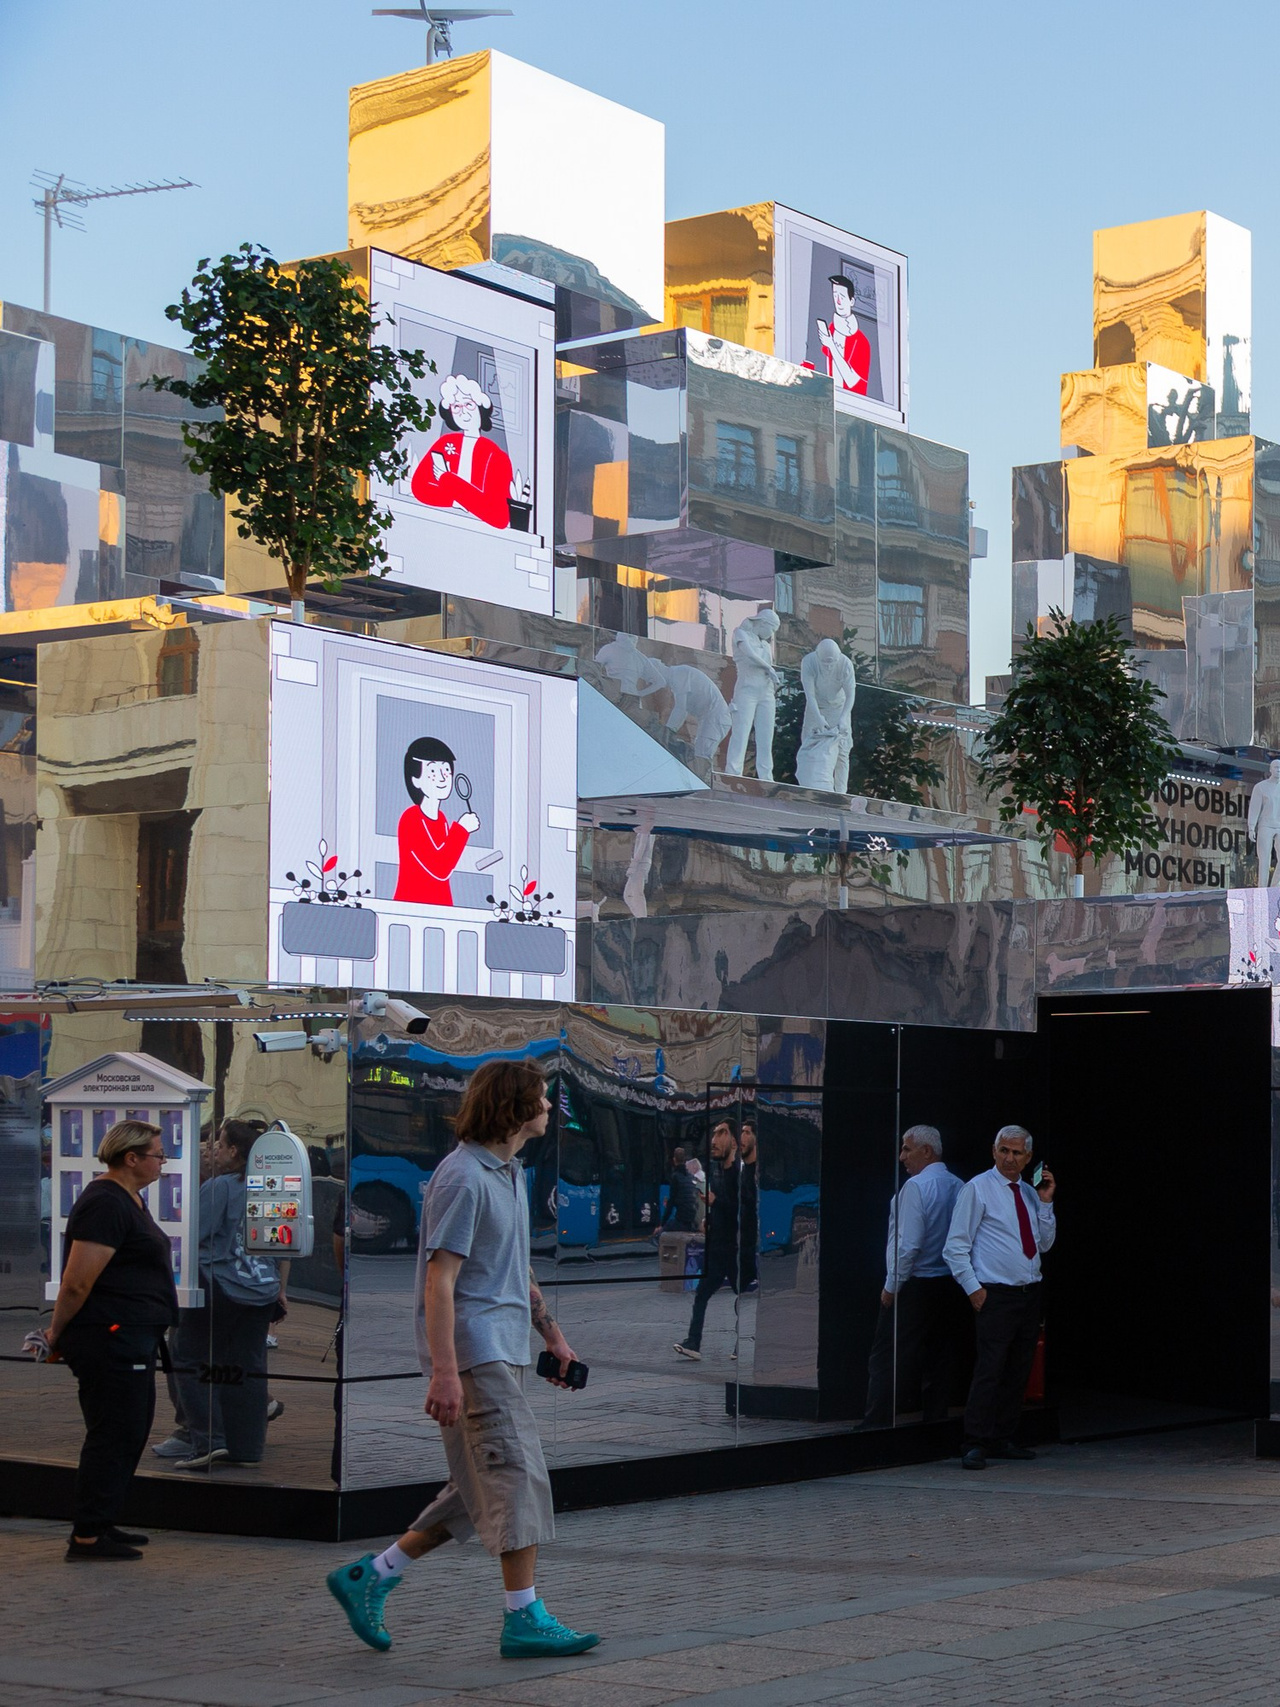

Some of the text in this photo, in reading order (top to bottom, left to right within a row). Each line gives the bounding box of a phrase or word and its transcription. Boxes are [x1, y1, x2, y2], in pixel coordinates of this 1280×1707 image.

[1124, 850, 1226, 889] МОСКВЫ
[96, 1073, 141, 1082] Московская
[83, 1084, 155, 1093] электронная школа
[199, 1363, 243, 1386] 2012
